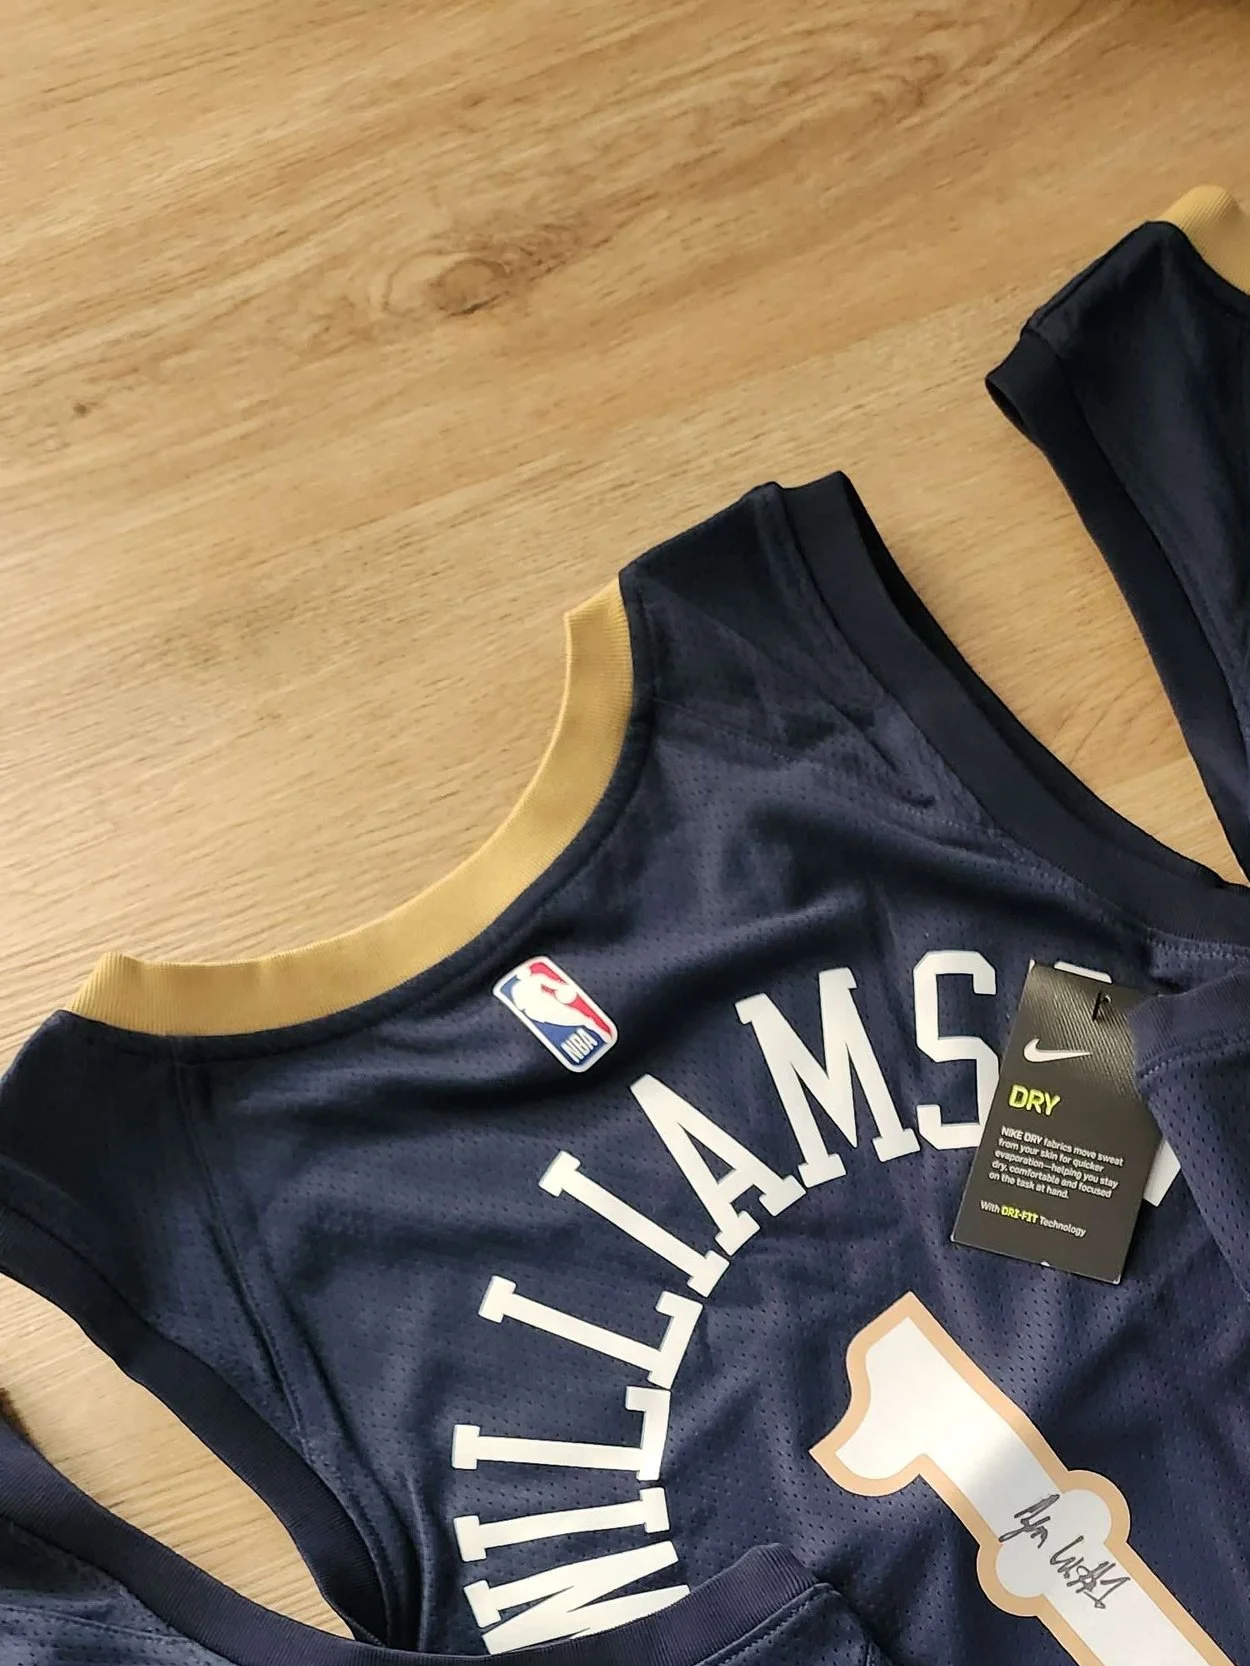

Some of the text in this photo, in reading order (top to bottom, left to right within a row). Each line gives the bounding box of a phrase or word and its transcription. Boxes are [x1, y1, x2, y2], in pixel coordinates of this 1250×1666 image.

[560, 1027, 599, 1064] NBA
[1008, 1084, 1061, 1116] DRY
[998, 1137, 1105, 1172] from your skin for quicker
[1001, 1125, 1124, 1167] NIKE DRY fabrics move sweat
[988, 1171, 1070, 1199] on the task at hand.
[1008, 1165, 1061, 1185] comfortable
[1060, 1178, 1078, 1189] and
[1078, 1181, 1113, 1198] focused
[1082, 1172, 1099, 1183] you
[1099, 1176, 1119, 1190] stay
[980, 1199, 1087, 1238] With DRI-FIT Technology
